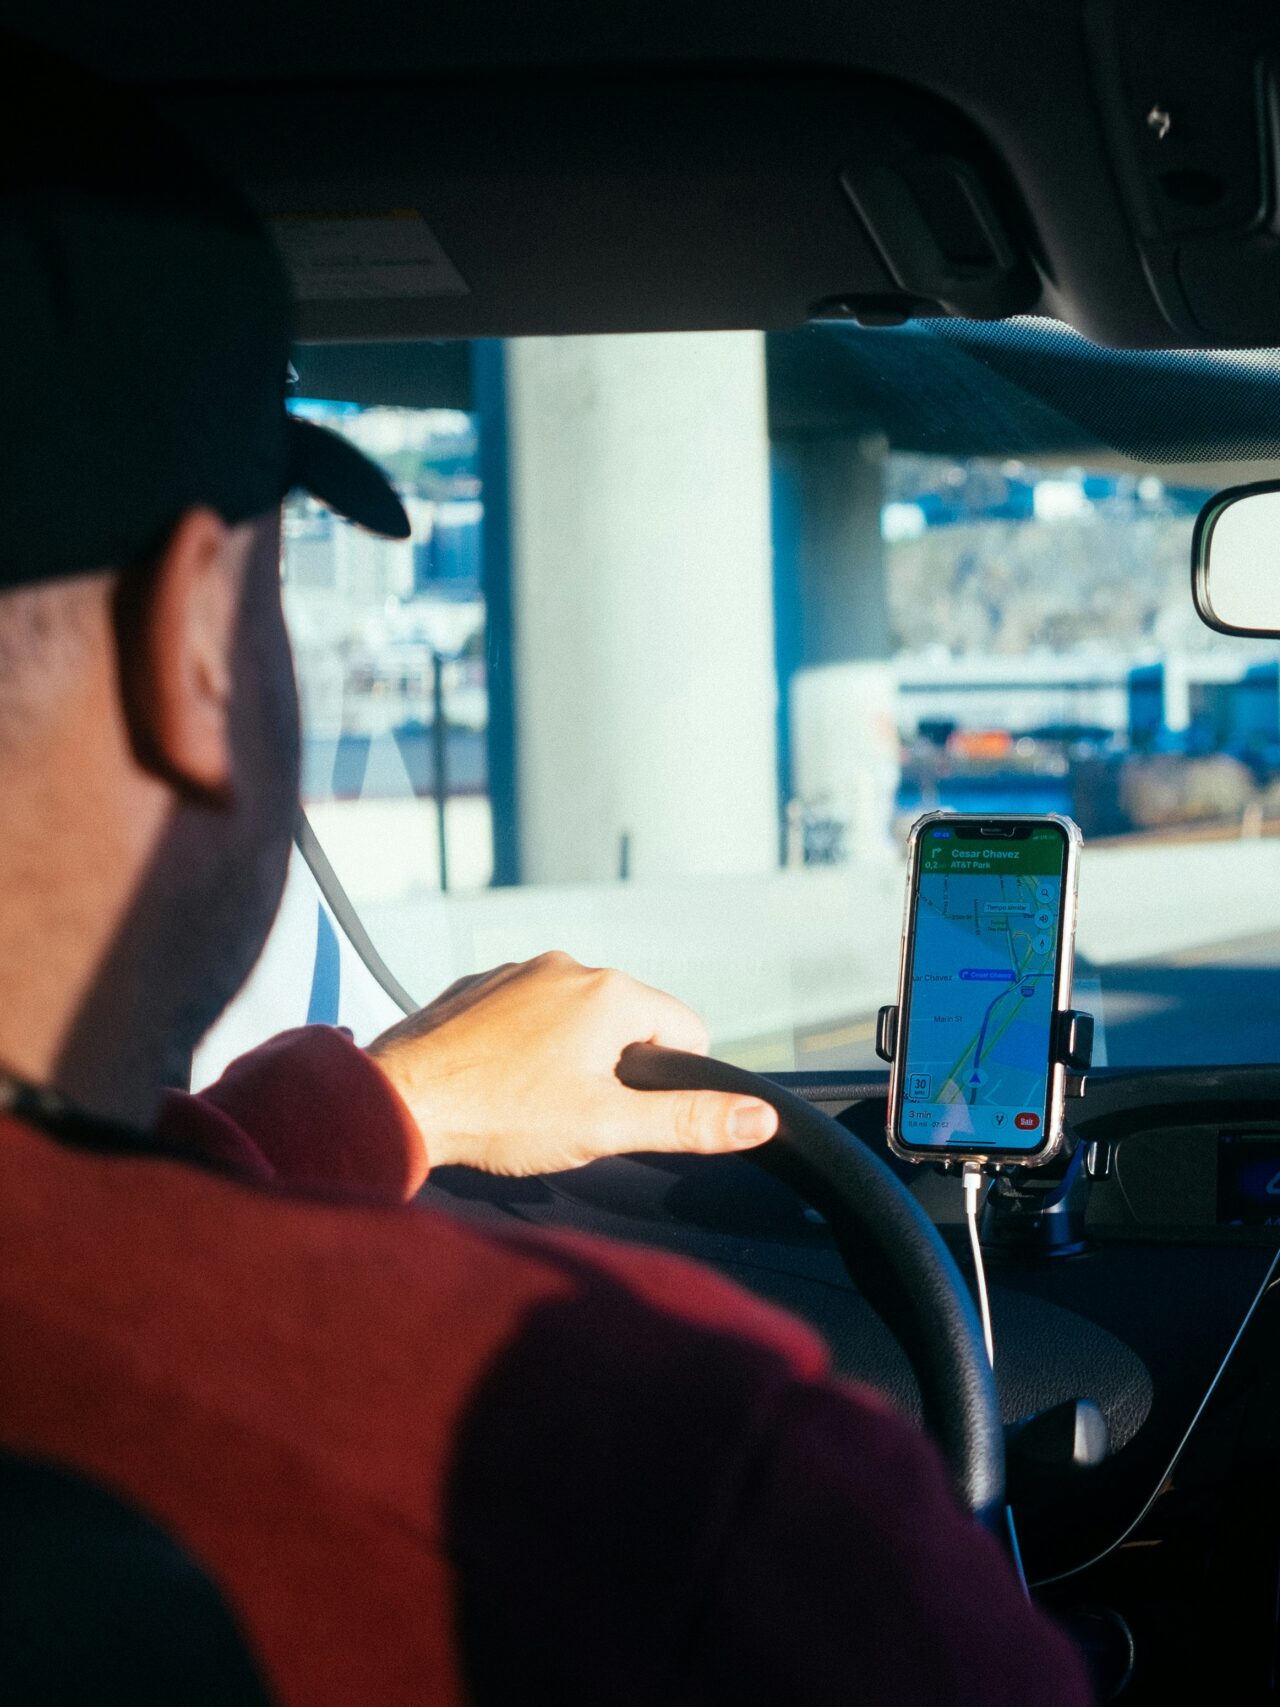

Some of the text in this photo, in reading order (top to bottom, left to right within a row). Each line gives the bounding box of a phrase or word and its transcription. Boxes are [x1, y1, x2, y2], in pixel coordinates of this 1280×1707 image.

[952, 849, 1020, 859] Cesar Chavez
[924, 861, 939, 870] 0,2
[950, 861, 972, 869] AT&T
[973, 861, 991, 869] Park
[924, 974, 953, 982] Chavez
[933, 1015, 962, 1024] Marin St
[914, 1079, 927, 1089] 30
[908, 1110, 932, 1118] 3 min
